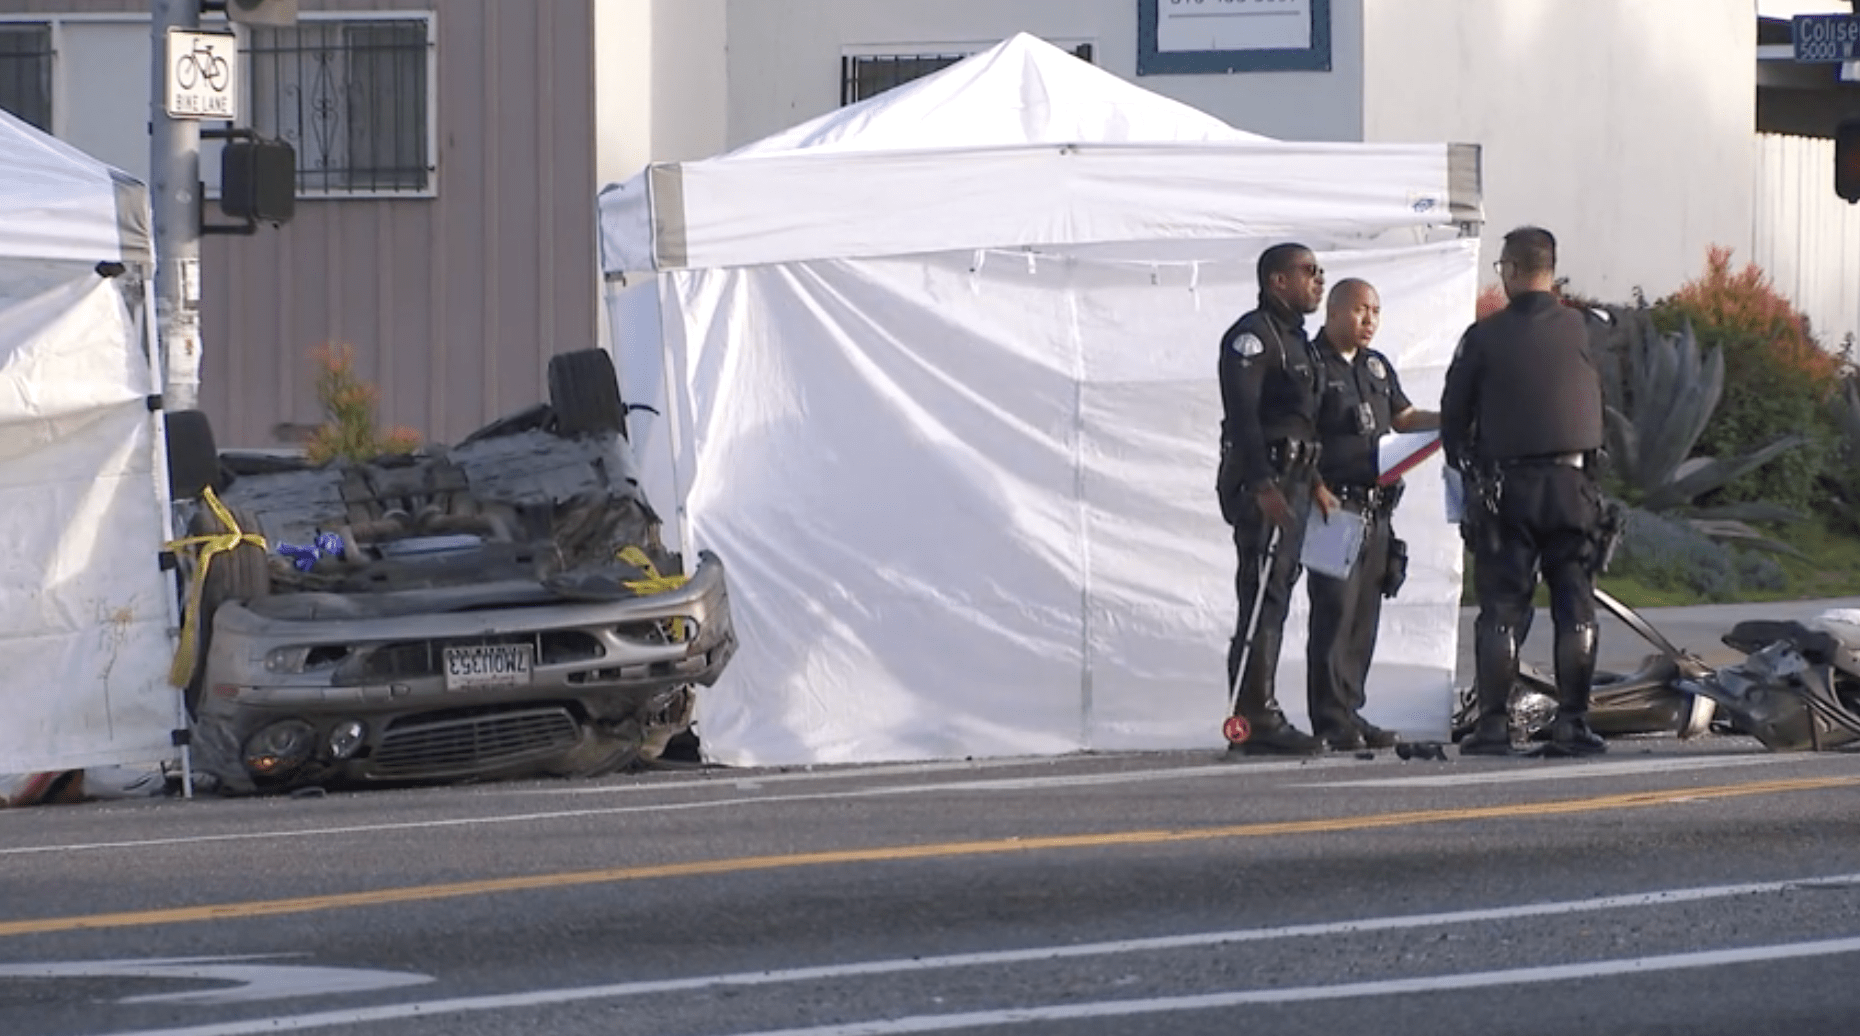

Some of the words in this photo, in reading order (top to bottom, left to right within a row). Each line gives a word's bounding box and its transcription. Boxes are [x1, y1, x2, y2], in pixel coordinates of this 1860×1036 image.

[1801, 42, 1836, 58] 5000
[1843, 42, 1853, 57] W
[176, 93, 198, 112] BIKE
[202, 95, 227, 113] LANE
